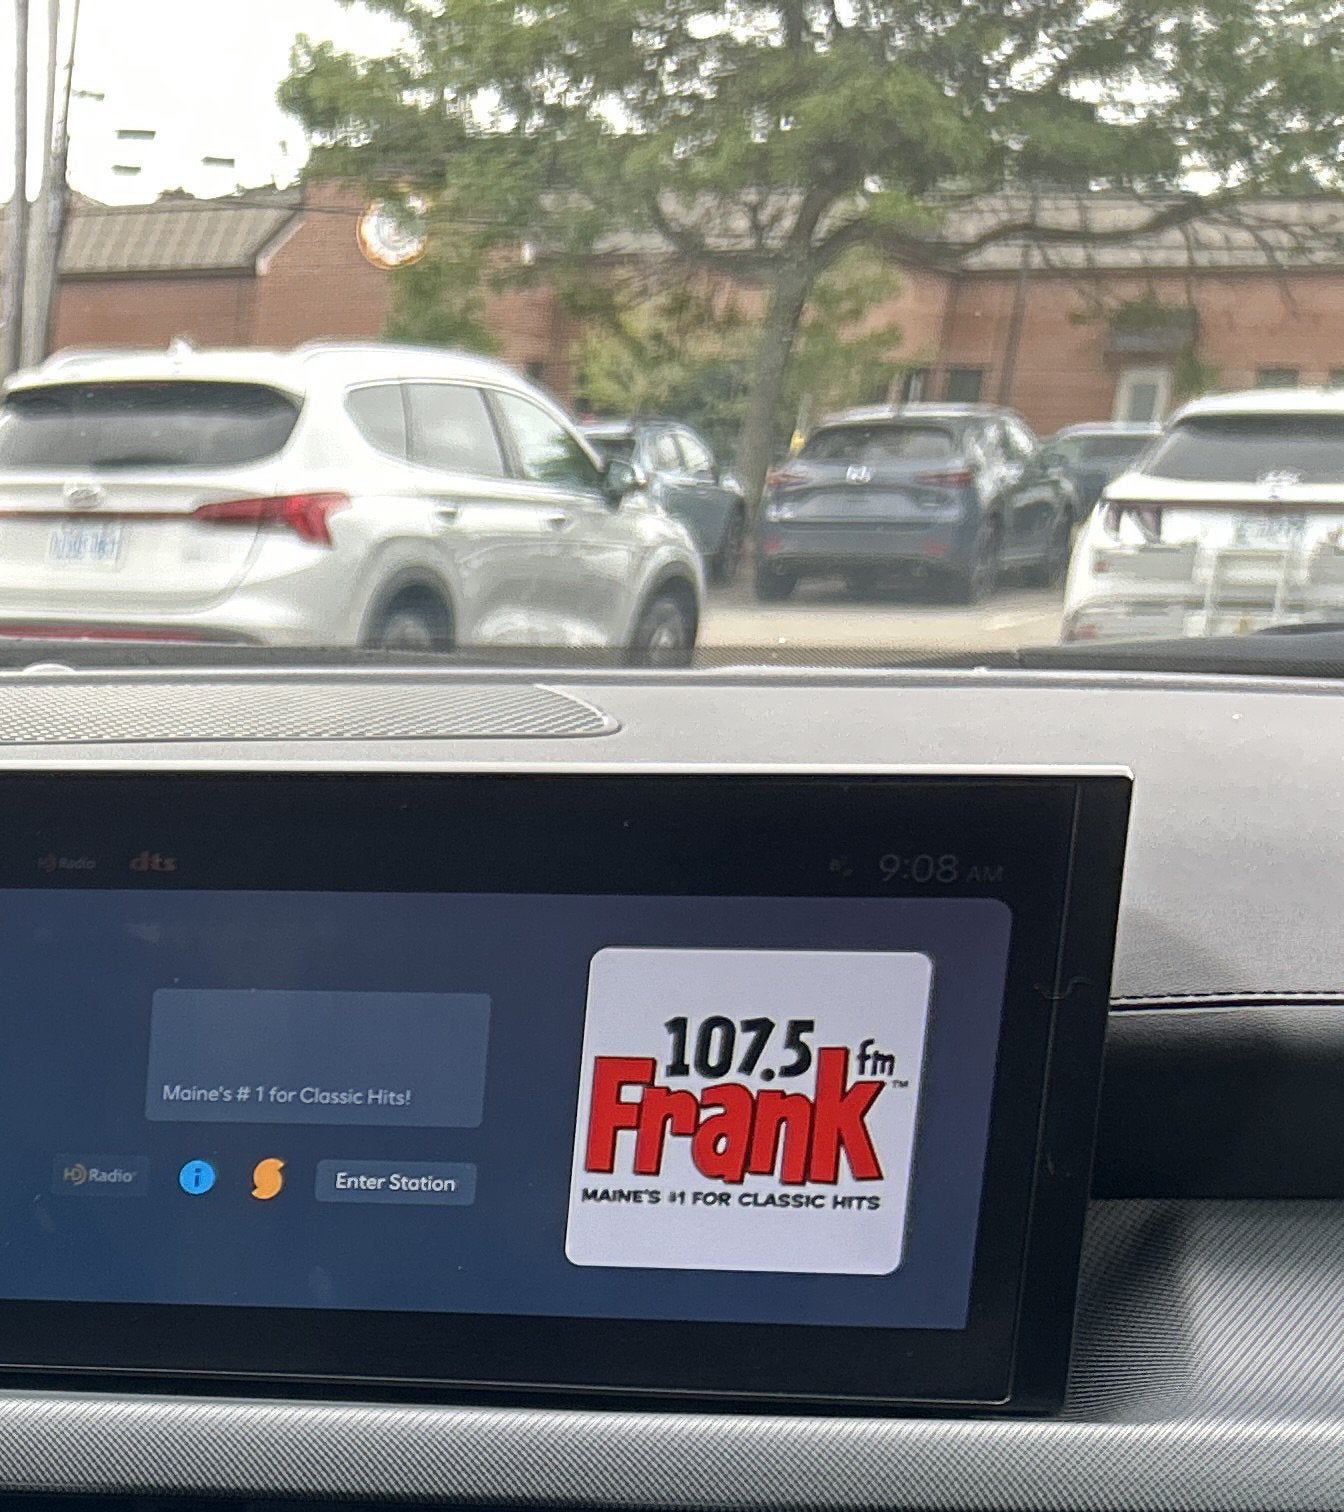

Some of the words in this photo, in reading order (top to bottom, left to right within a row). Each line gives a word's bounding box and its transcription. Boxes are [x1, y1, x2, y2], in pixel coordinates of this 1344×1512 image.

[879, 854, 958, 883] 9:08
[665, 1016, 814, 1081] 107.5
[857, 1040, 896, 1076] fm
[162, 1084, 231, 1102] Maine's
[236, 1086, 251, 1102] #
[255, 1086, 265, 1102] 1
[267, 1086, 297, 1103] for
[300, 1087, 363, 1106] Classic
[368, 1088, 411, 1106] Hits!
[585, 1047, 886, 1185] Frank
[89, 1168, 133, 1182] Radio
[335, 1171, 385, 1190] Enter
[389, 1172, 456, 1192] Station
[581, 1188, 661, 1205] MAINE'S
[692, 1191, 731, 1207] FOR
[738, 1192, 825, 1209] CLASSIC
[832, 1195, 880, 1211] HITS
